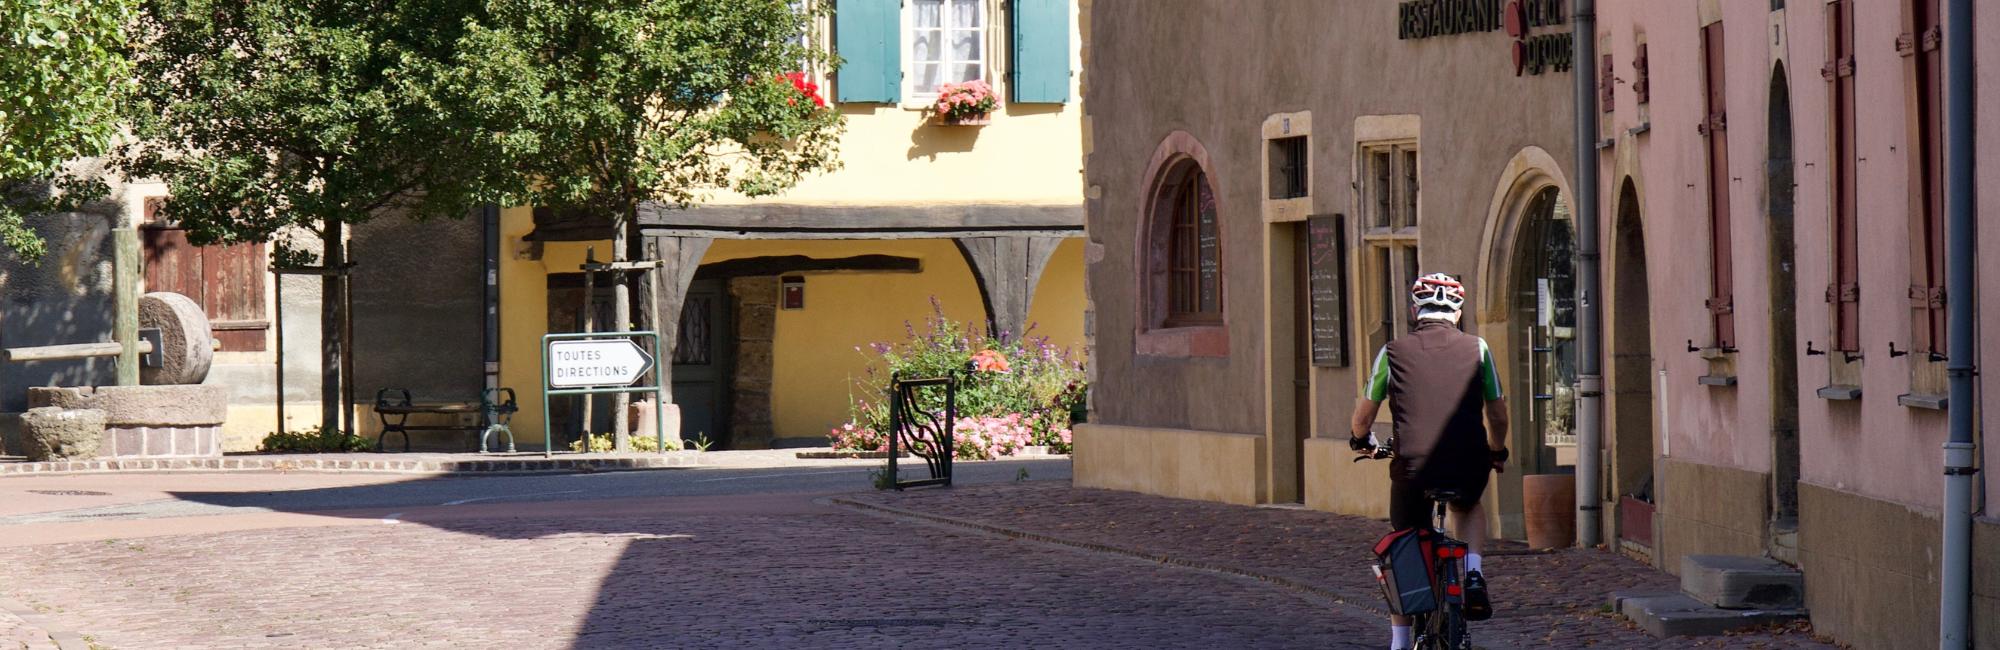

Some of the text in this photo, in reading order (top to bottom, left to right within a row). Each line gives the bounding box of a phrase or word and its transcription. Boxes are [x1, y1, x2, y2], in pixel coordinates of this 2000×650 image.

[1398, 0, 1500, 40] RESTAURANT
[557, 350, 601, 361] TOUTES
[557, 366, 628, 378] DIRECTIONS
